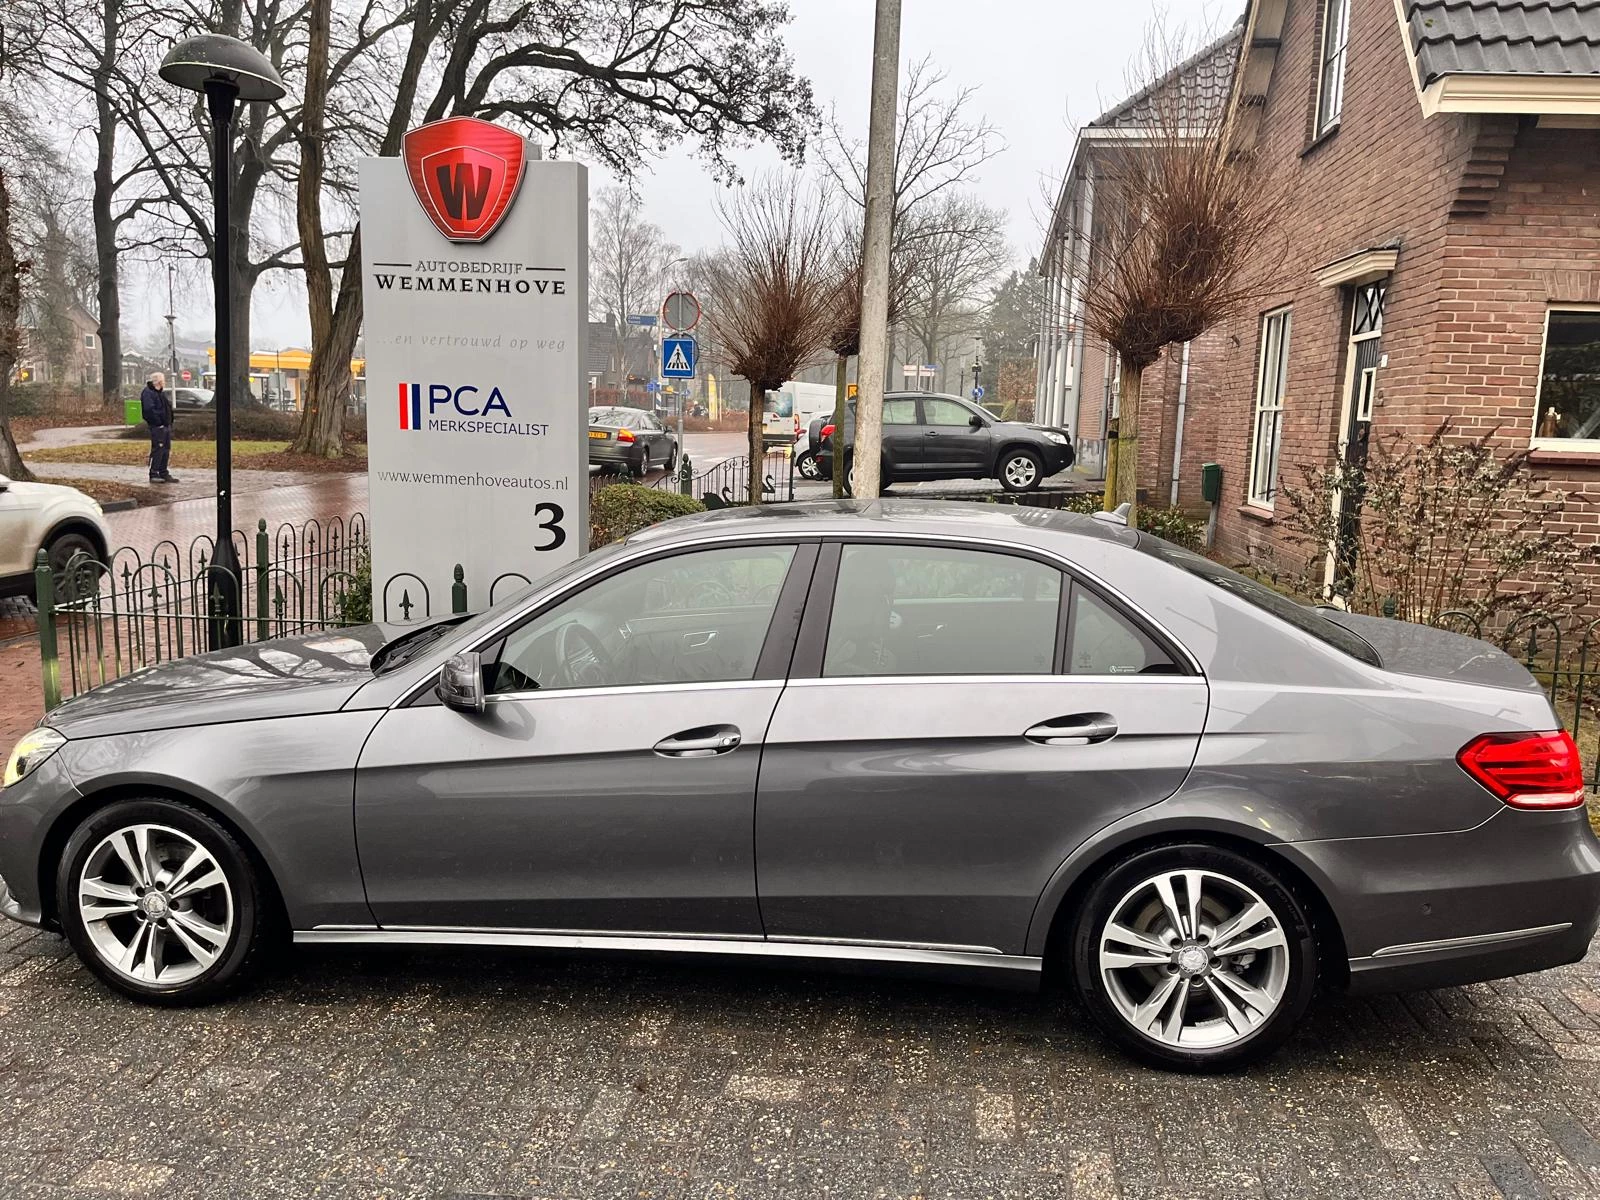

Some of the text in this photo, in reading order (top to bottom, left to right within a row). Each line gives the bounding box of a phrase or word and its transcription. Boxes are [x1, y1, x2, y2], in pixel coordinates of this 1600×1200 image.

[436, 163, 492, 221] W
[415, 260, 523, 275] AUTOBEDRIJF
[373, 274, 566, 295] WEMMENHOVE
[421, 335, 501, 348] vertrouwd
[510, 339, 528, 350] op
[536, 339, 566, 352] weg
[428, 384, 512, 417] PCA
[428, 419, 549, 436] MERKSPECIALIST
[377, 471, 569, 490] www.wemmenhoveautos.nl
[533, 502, 567, 551] 3
